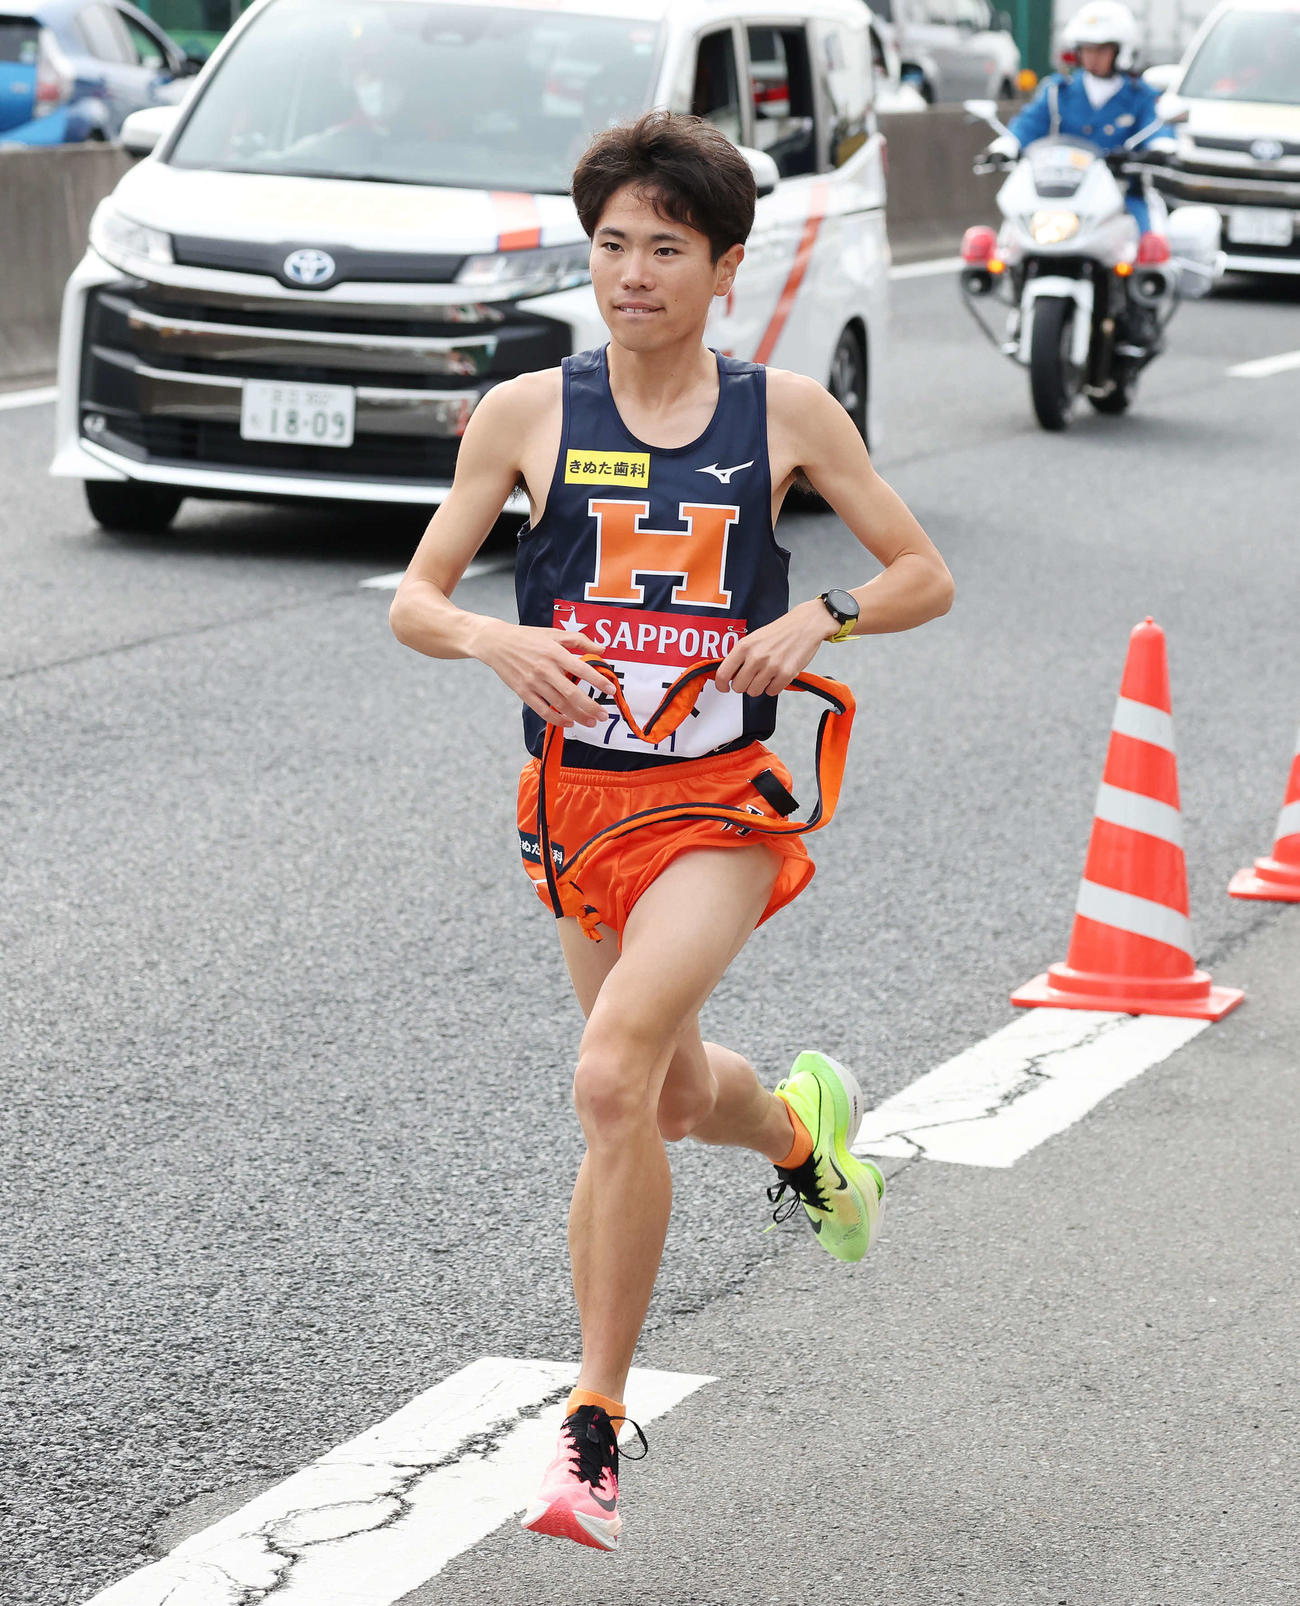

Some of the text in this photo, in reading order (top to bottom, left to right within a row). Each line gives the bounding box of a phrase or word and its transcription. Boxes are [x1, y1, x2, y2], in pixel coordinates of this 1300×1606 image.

[569, 459, 646, 478] きぬた歯科
[584, 498, 740, 609] H
[593, 618, 740, 659] SAPPORO
[519, 837, 563, 865] ぬた科
